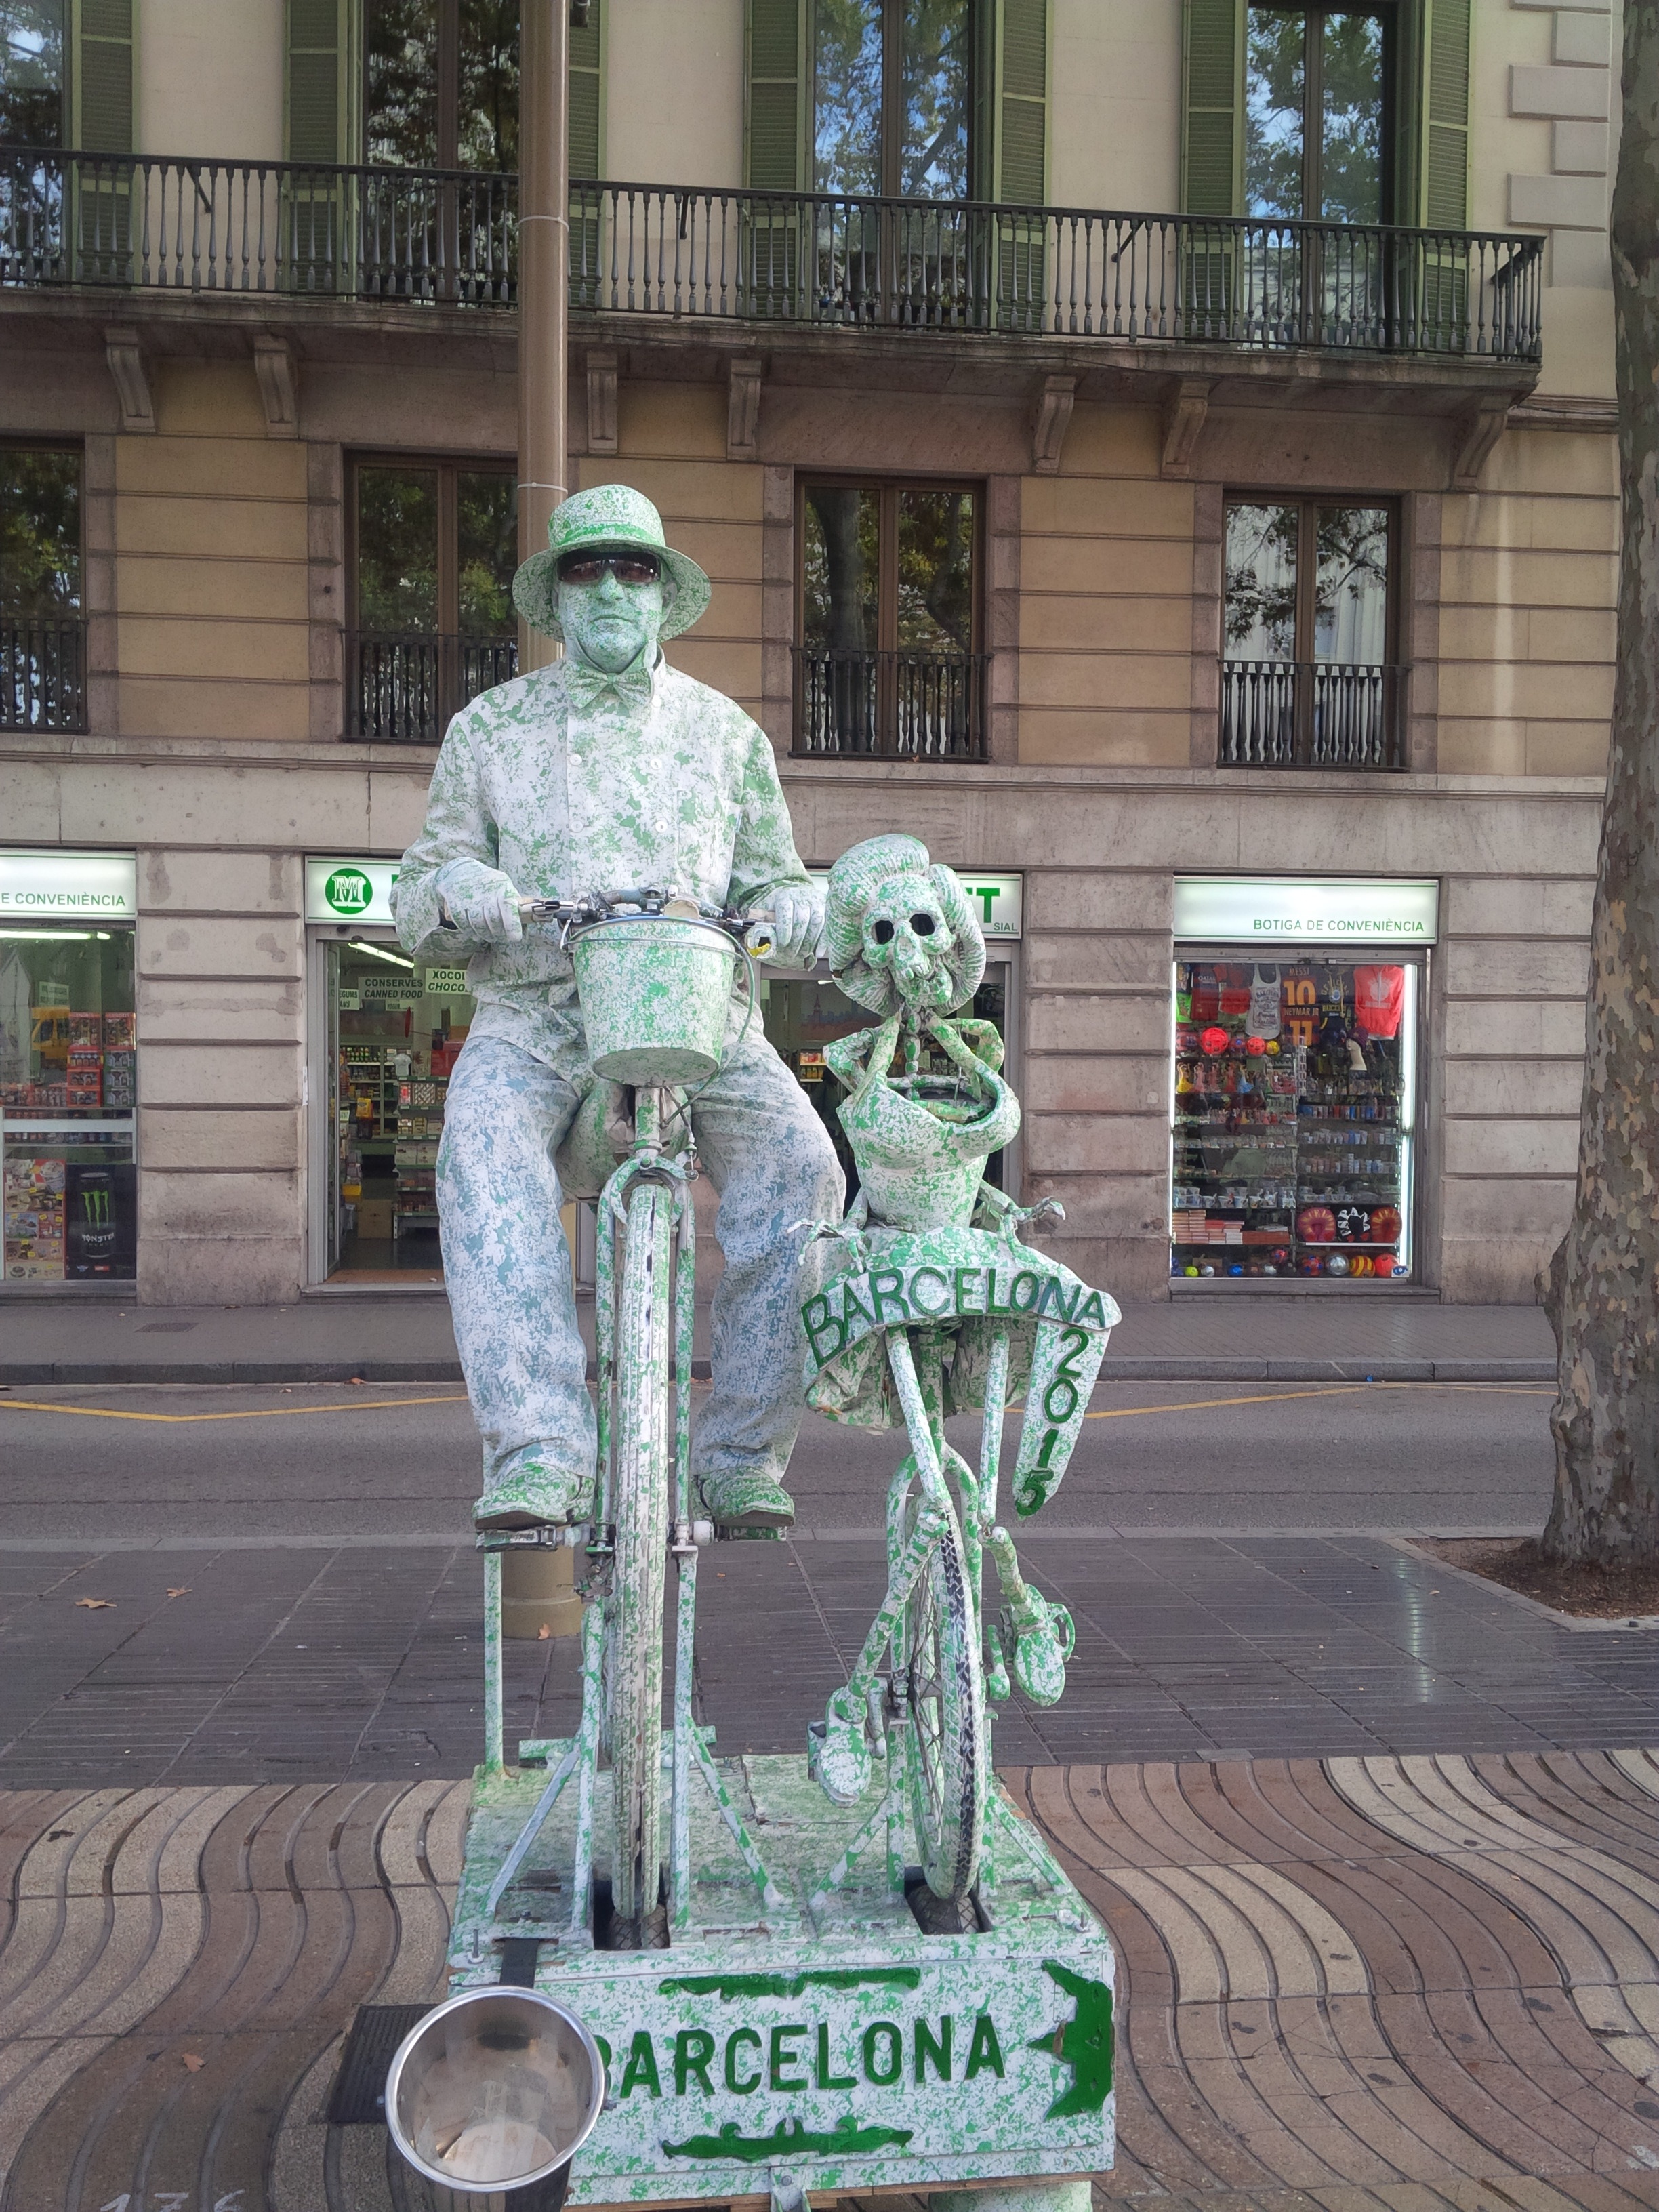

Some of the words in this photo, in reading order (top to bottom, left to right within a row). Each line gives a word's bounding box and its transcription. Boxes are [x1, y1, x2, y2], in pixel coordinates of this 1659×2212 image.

[15, 892, 126, 907] CONVENIÈNCIA
[994, 922, 1018, 931] SIAL
[1254, 919, 1302, 930] BOTIGA
[1307, 920, 1324, 930] DE
[1328, 918, 1425, 932] CONVENIÈNCIA
[1290, 967, 1309, 976] MESSI
[365, 978, 424, 987] CONSERVES
[364, 989, 398, 998] CANNED
[400, 990, 423, 998] FOOD
[1283, 980, 1316, 1006] 10
[1284, 1008, 1310, 1016] NEYMAR
[1290, 1020, 1313, 1046] 11
[802, 1266, 1106, 1369] BARCELONA
[1015, 1327, 1090, 1516] 2015
